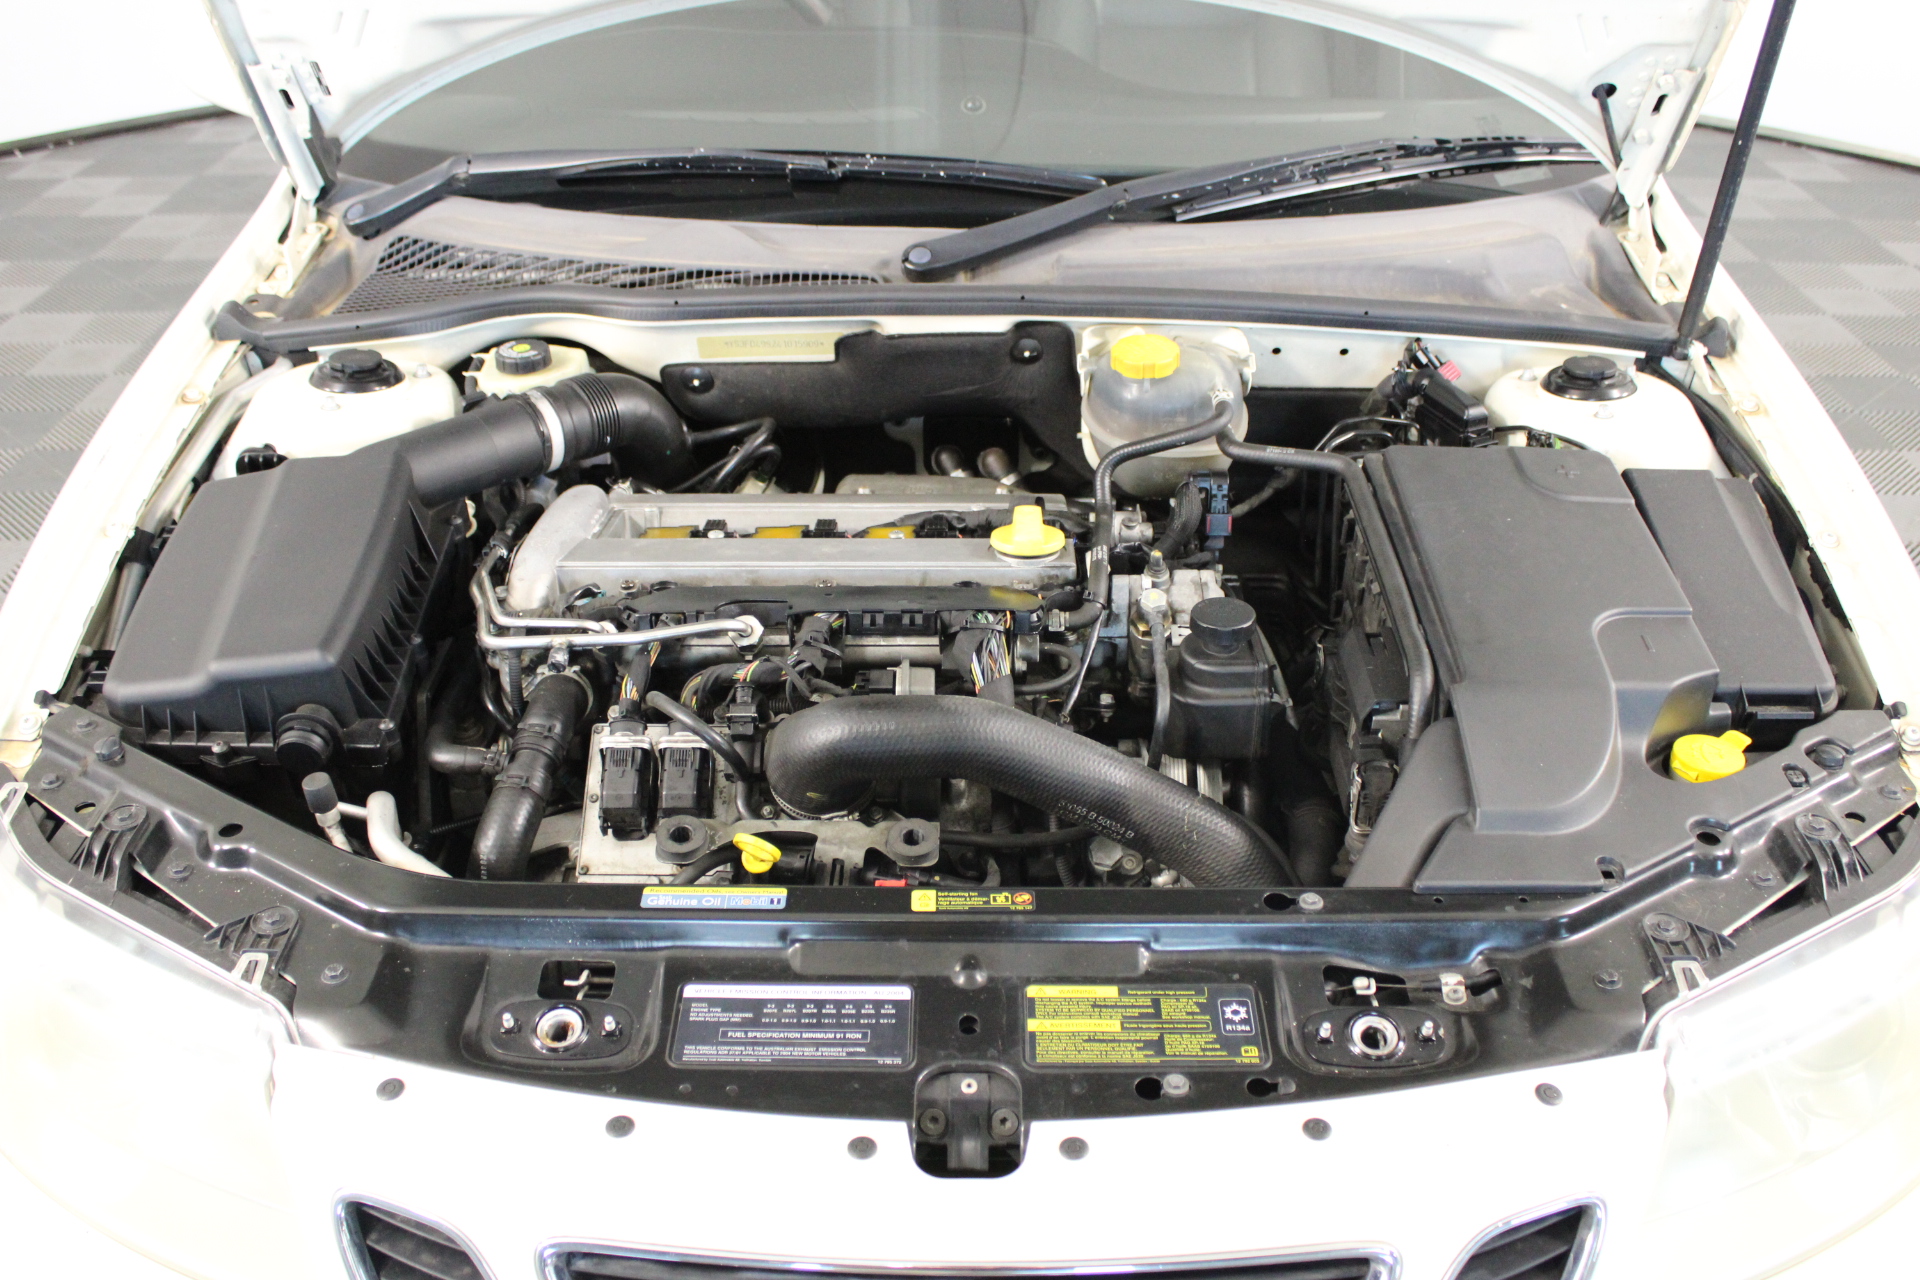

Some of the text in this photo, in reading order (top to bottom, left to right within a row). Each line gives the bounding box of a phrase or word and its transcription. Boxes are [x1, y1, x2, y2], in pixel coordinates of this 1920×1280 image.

[647, 897, 721, 906] Genuine Oil
[730, 897, 767, 906] Mobil
[747, 1031, 801, 1039] SPECIFICATION
